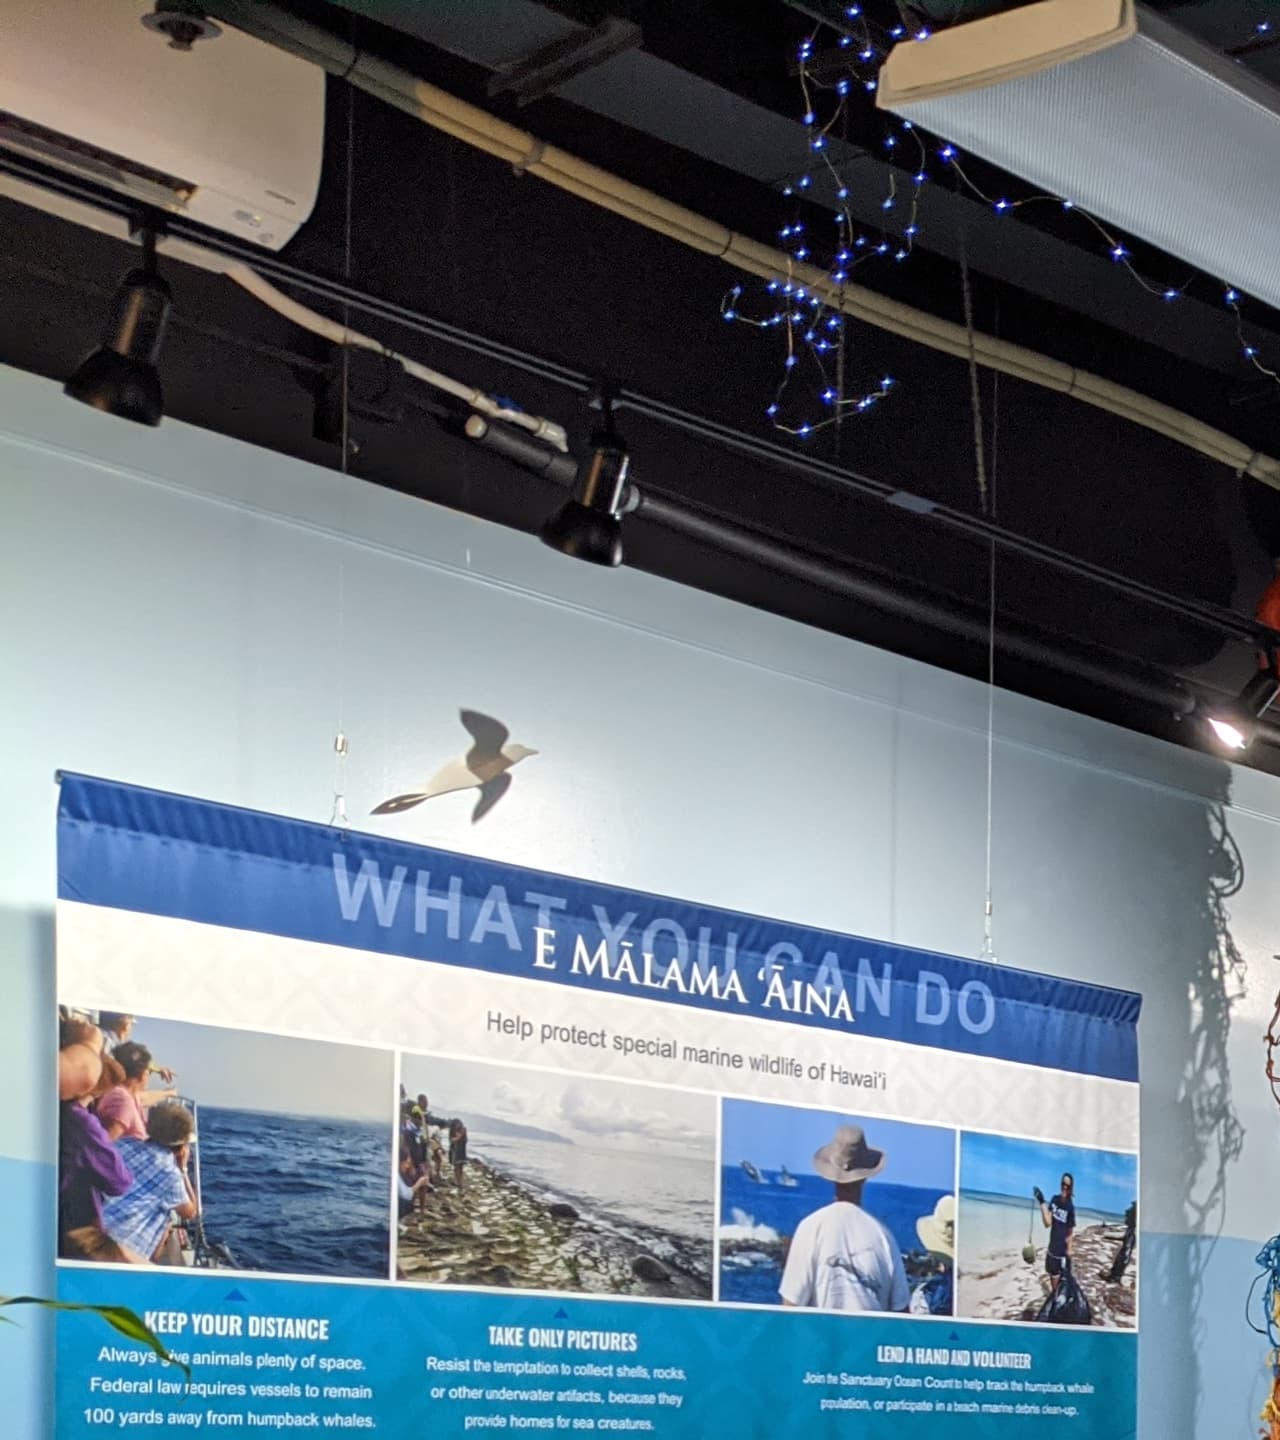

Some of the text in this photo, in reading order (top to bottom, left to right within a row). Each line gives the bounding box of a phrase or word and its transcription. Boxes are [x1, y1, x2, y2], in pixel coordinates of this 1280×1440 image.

[332, 852, 996, 1035] WHAT YOU CAN DO
[532, 925, 556, 970] E
[570, 933, 750, 1004] MĀLAMA
[488, 1010, 533, 1041] Help
[541, 1024, 606, 1049] protect
[613, 1035, 676, 1059] special
[683, 1046, 743, 1069] marine
[749, 1054, 802, 1078] wildlife
[808, 1062, 826, 1081] of
[145, 1311, 328, 1340] KEEP YOUR DISTANCE
[489, 1326, 637, 1352] TAKE ONLY PICTURES
[98, 1347, 157, 1366] Always
[193, 1350, 253, 1367] animals
[257, 1353, 297, 1371] plenty
[301, 1354, 315, 1369] of
[320, 1357, 365, 1372] space.
[90, 1376, 372, 1399] Federal law requires vessels to remain
[84, 1408, 376, 1429] 100 yards away from humpback whales.
